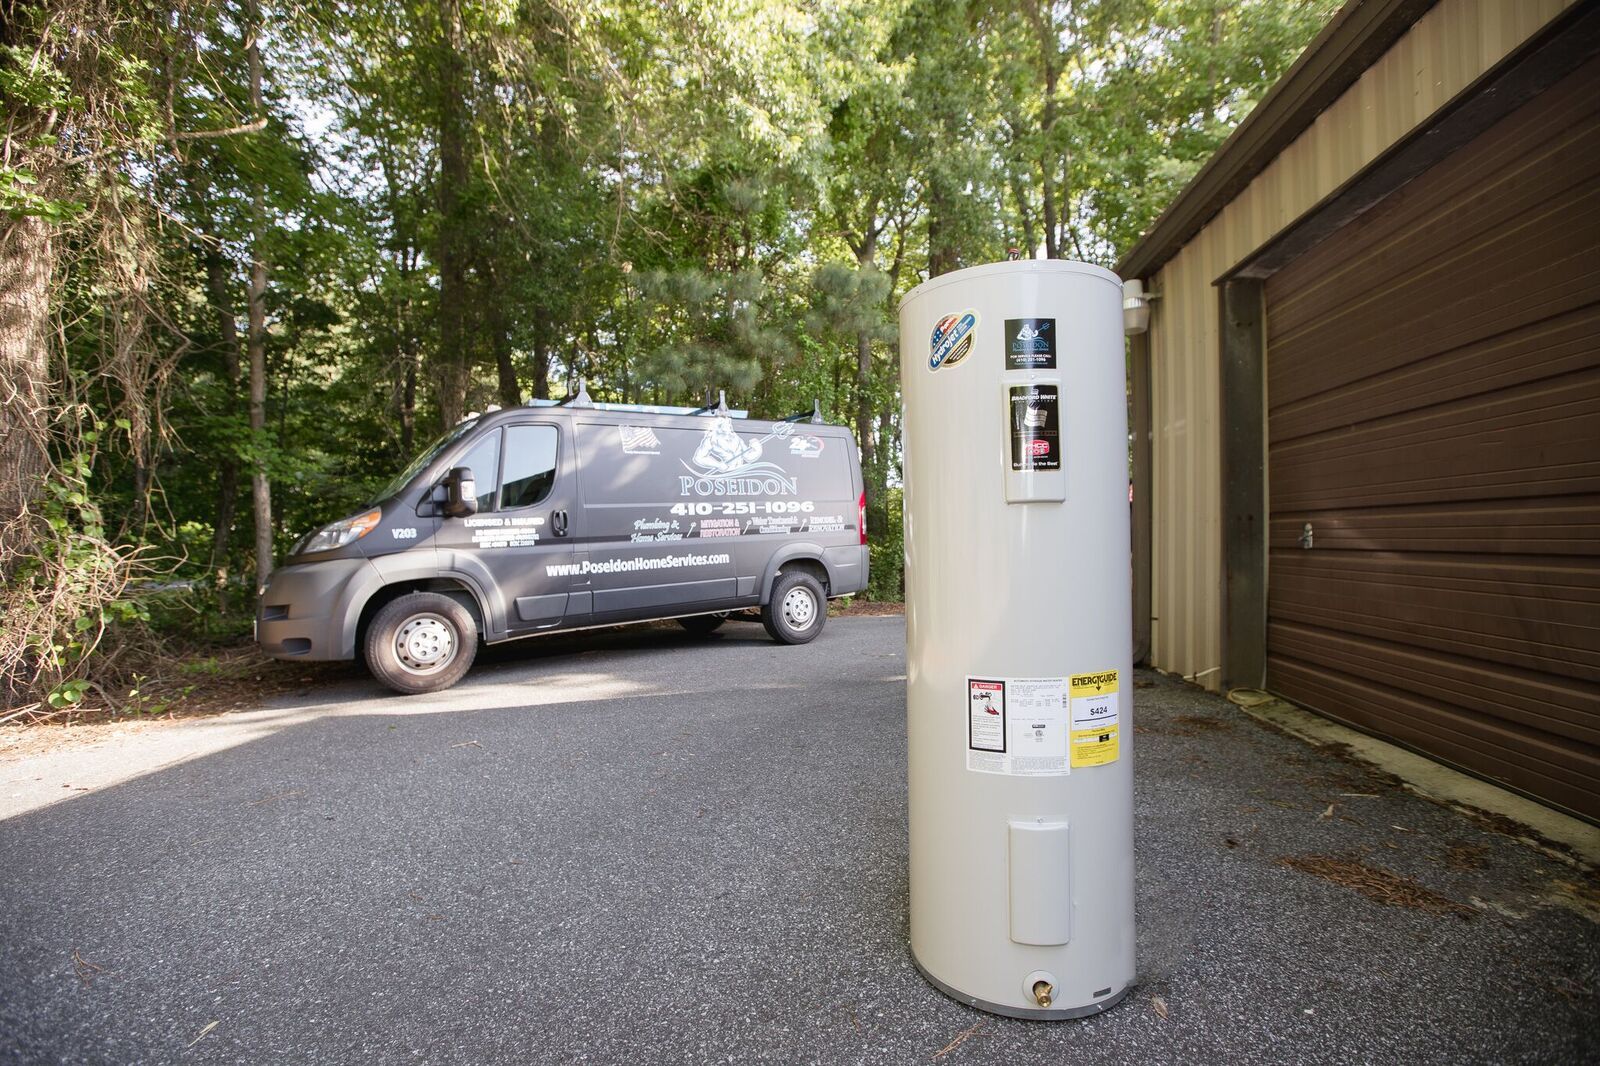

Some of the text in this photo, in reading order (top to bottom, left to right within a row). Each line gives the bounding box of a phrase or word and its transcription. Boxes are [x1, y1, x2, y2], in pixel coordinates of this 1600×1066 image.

[932, 329, 958, 365] Hydrojet
[679, 475, 797, 497] POSEIDON
[670, 500, 815, 516] 410-251-1096
[464, 518, 503, 527] LICENSED
[634, 517, 670, 533] Plumbing
[392, 527, 417, 540] V203
[630, 531, 683, 544] Home Services
[546, 553, 730, 577] www.PoseidonHomeServices.com
